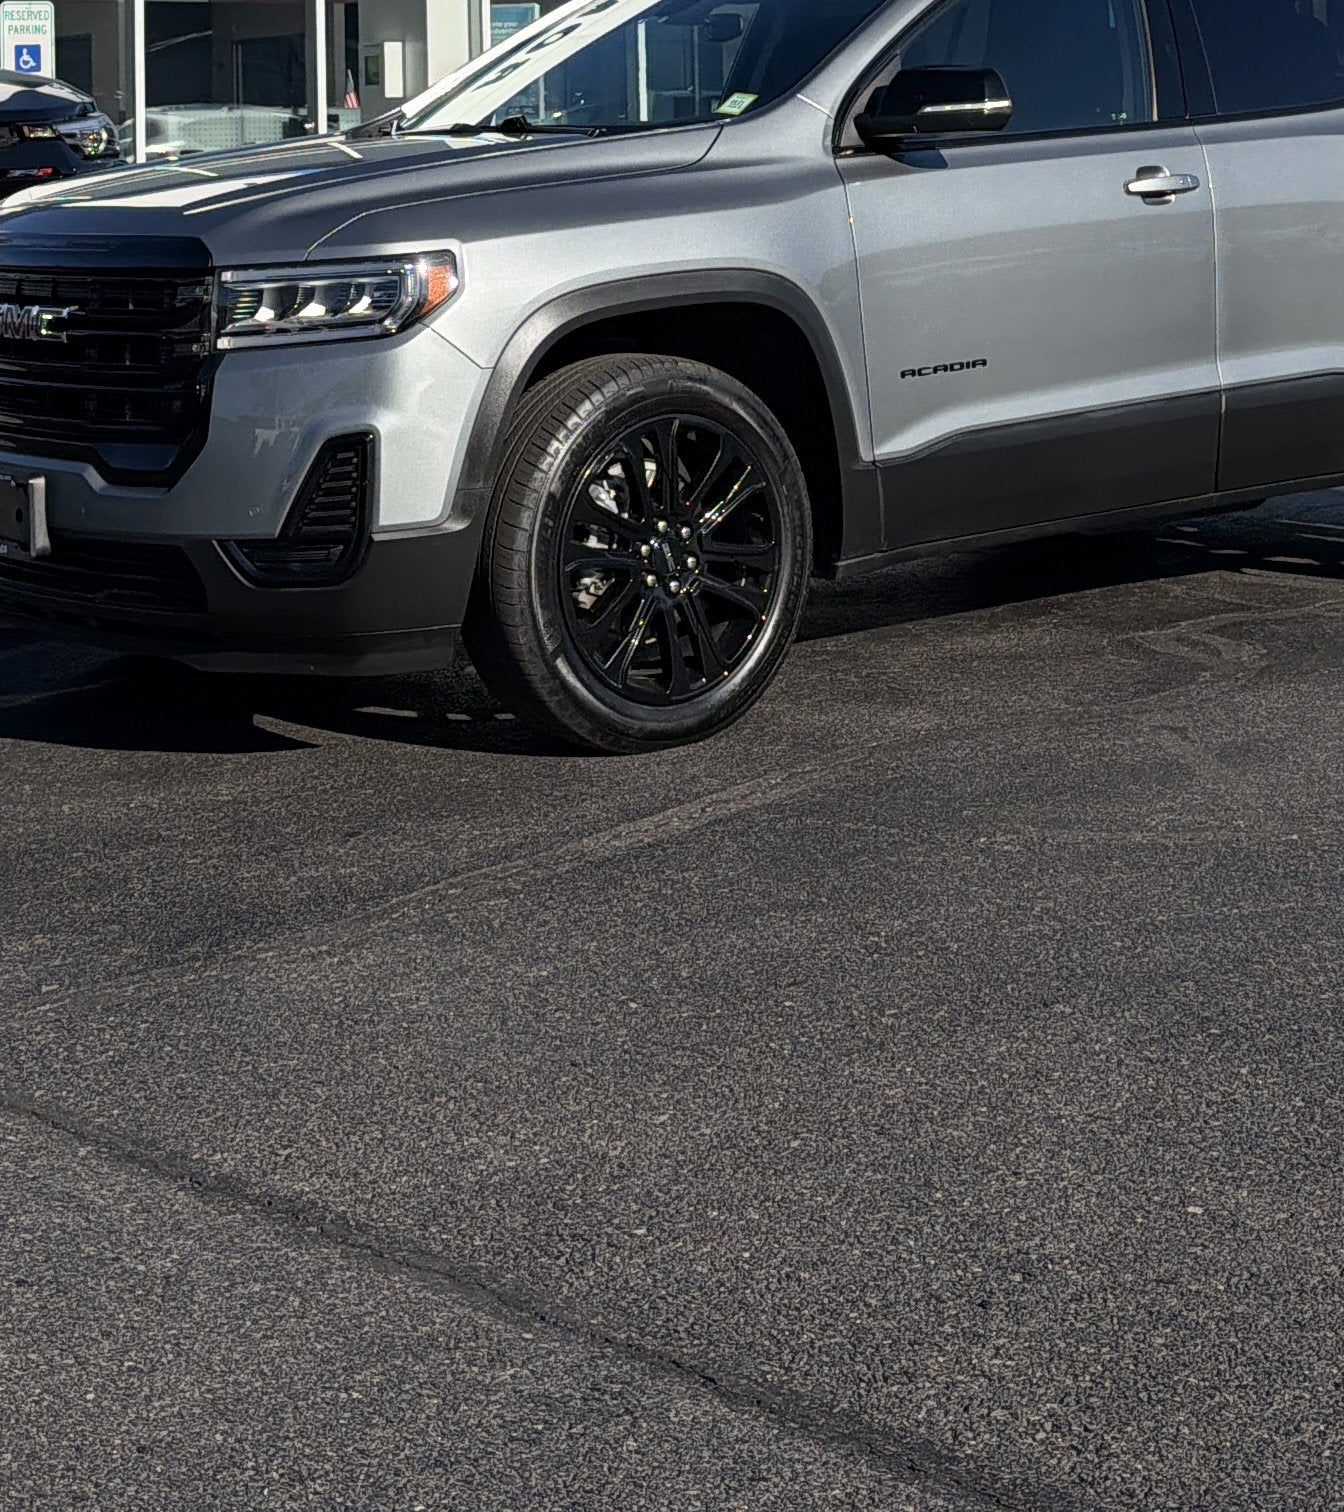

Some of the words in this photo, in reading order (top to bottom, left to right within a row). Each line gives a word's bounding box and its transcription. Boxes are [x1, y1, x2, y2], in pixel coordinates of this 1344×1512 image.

[4, 10, 50, 21] RESERVED
[7, 24, 47, 35] PARKING
[900, 358, 987, 379] ACADIA
